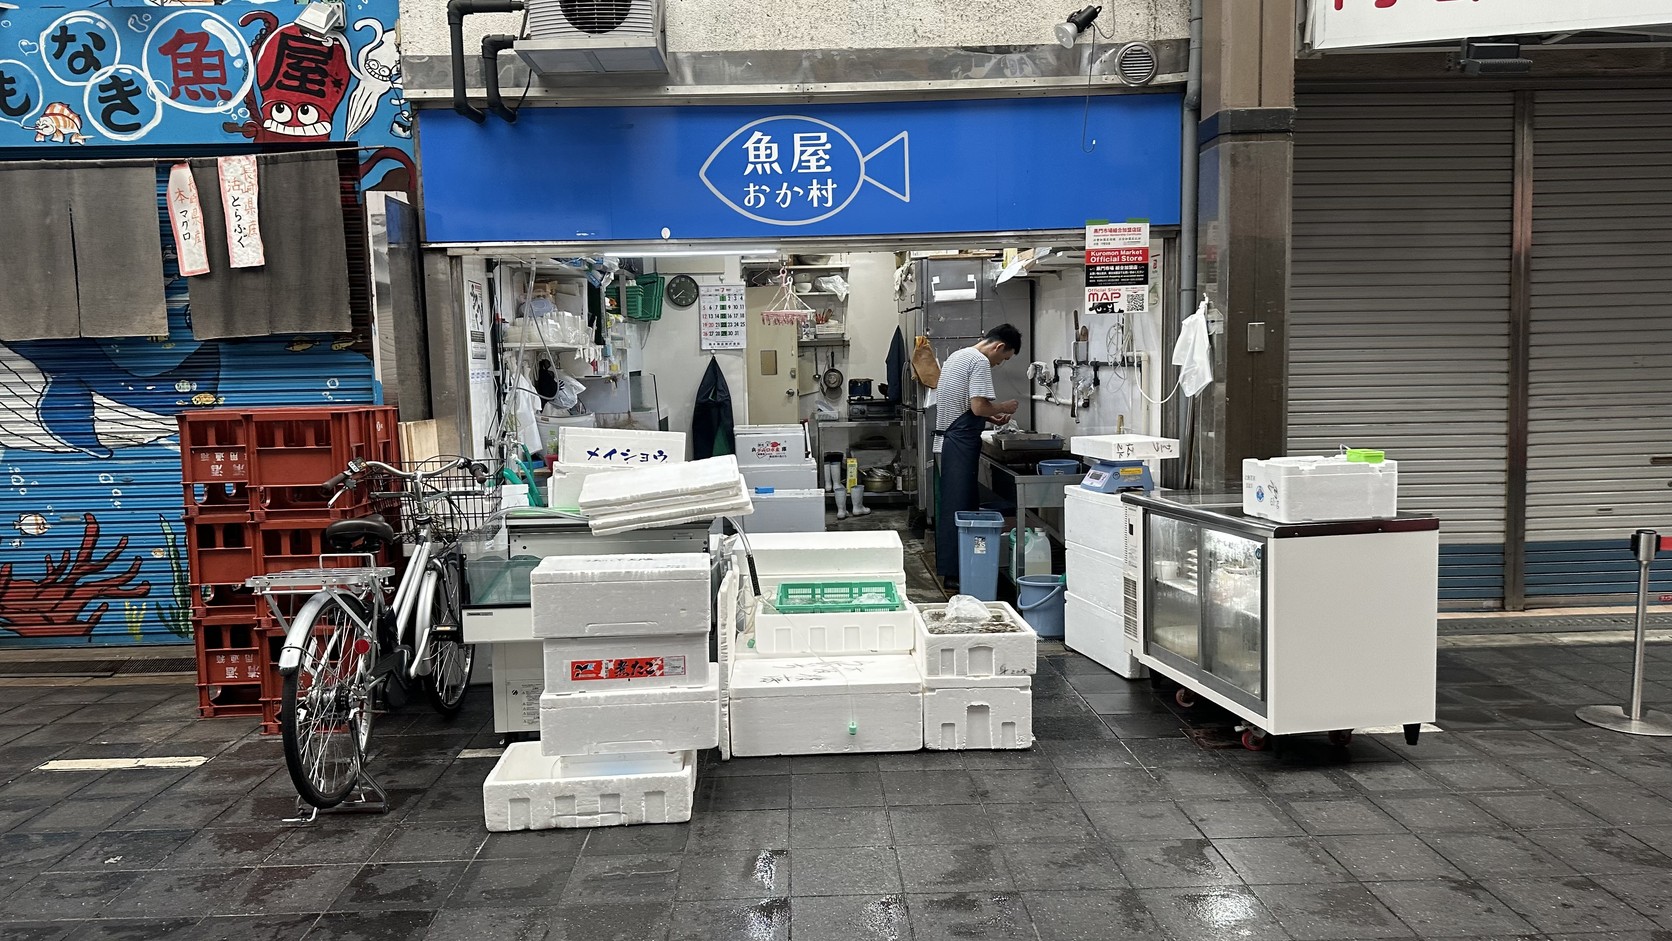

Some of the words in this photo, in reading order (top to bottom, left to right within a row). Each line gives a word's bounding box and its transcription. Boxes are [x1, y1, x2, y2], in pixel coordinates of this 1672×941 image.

[742, 131, 832, 176] 魚屋
[744, 178, 837, 208] おか村
[174, 187, 191, 241] 本マグロ
[1088, 292, 1121, 302] MAP
